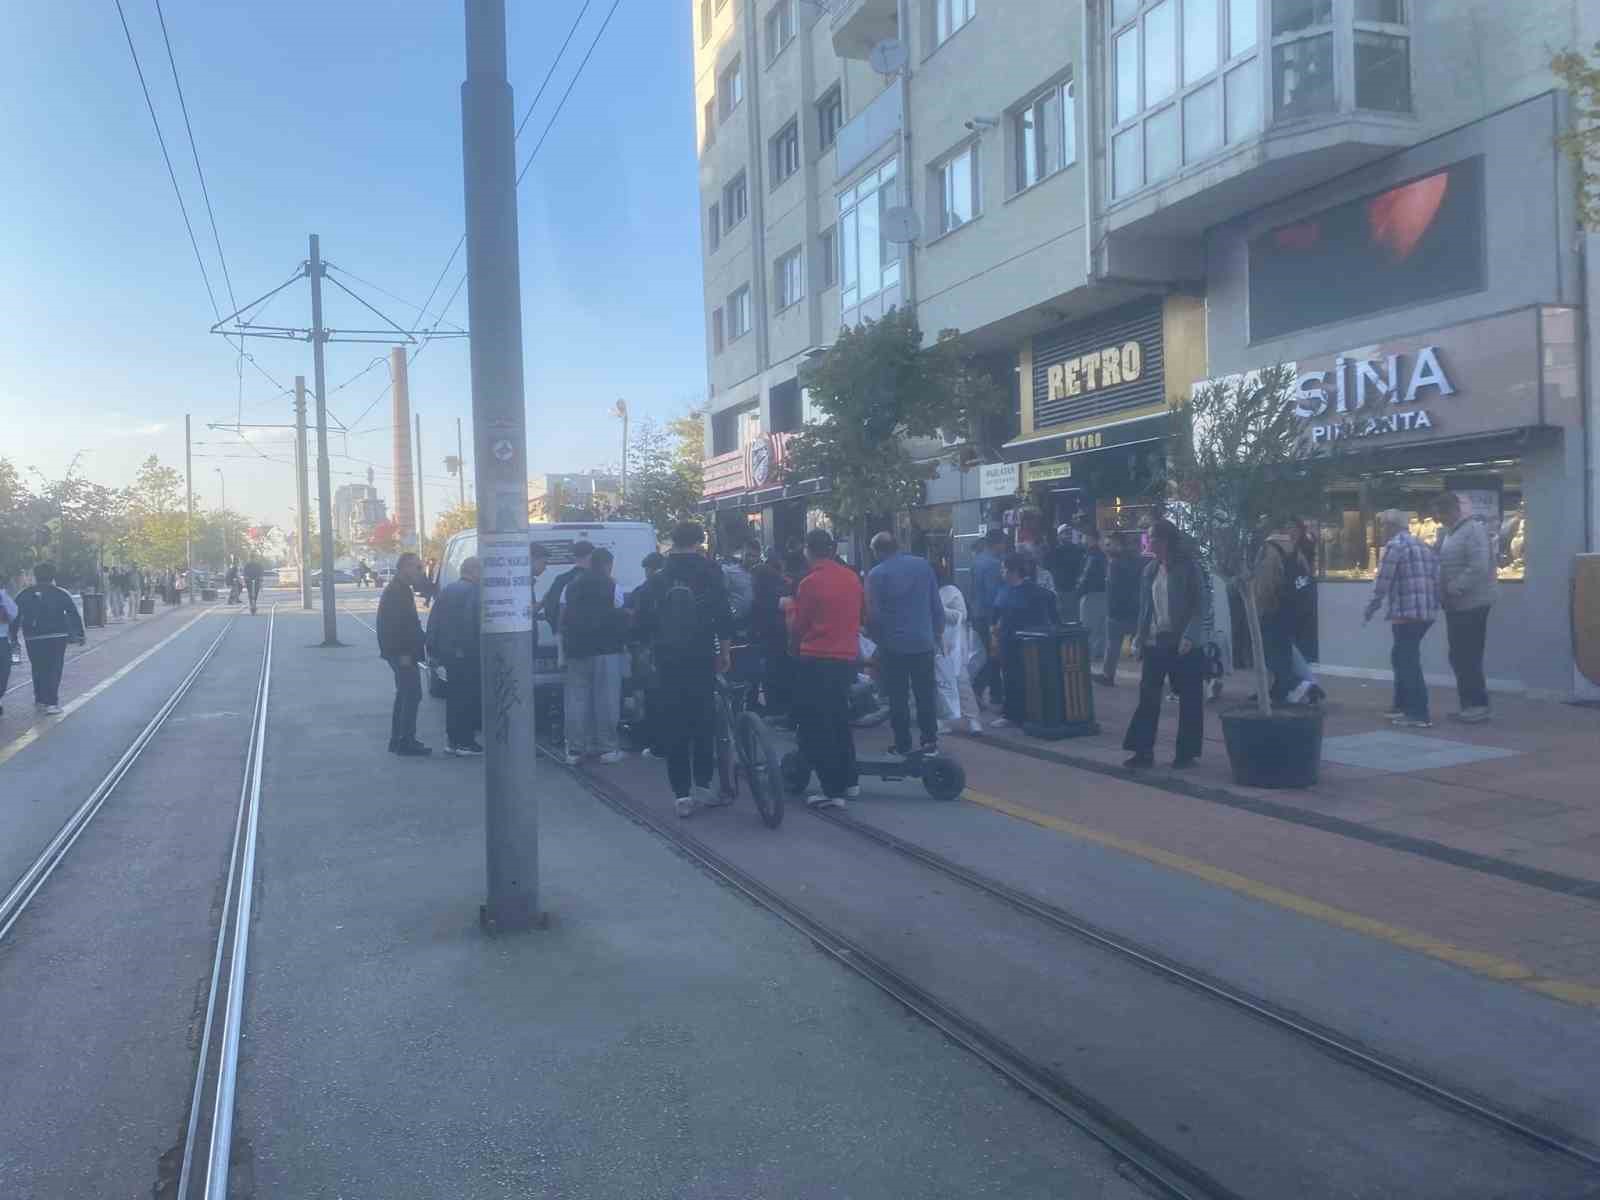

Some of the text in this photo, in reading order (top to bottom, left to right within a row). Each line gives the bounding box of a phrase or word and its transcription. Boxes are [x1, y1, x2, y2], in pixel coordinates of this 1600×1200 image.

[1047, 341, 1141, 401] RETRO
[1065, 432, 1103, 452] RETRO
[1312, 410, 1431, 442] PIANTA
